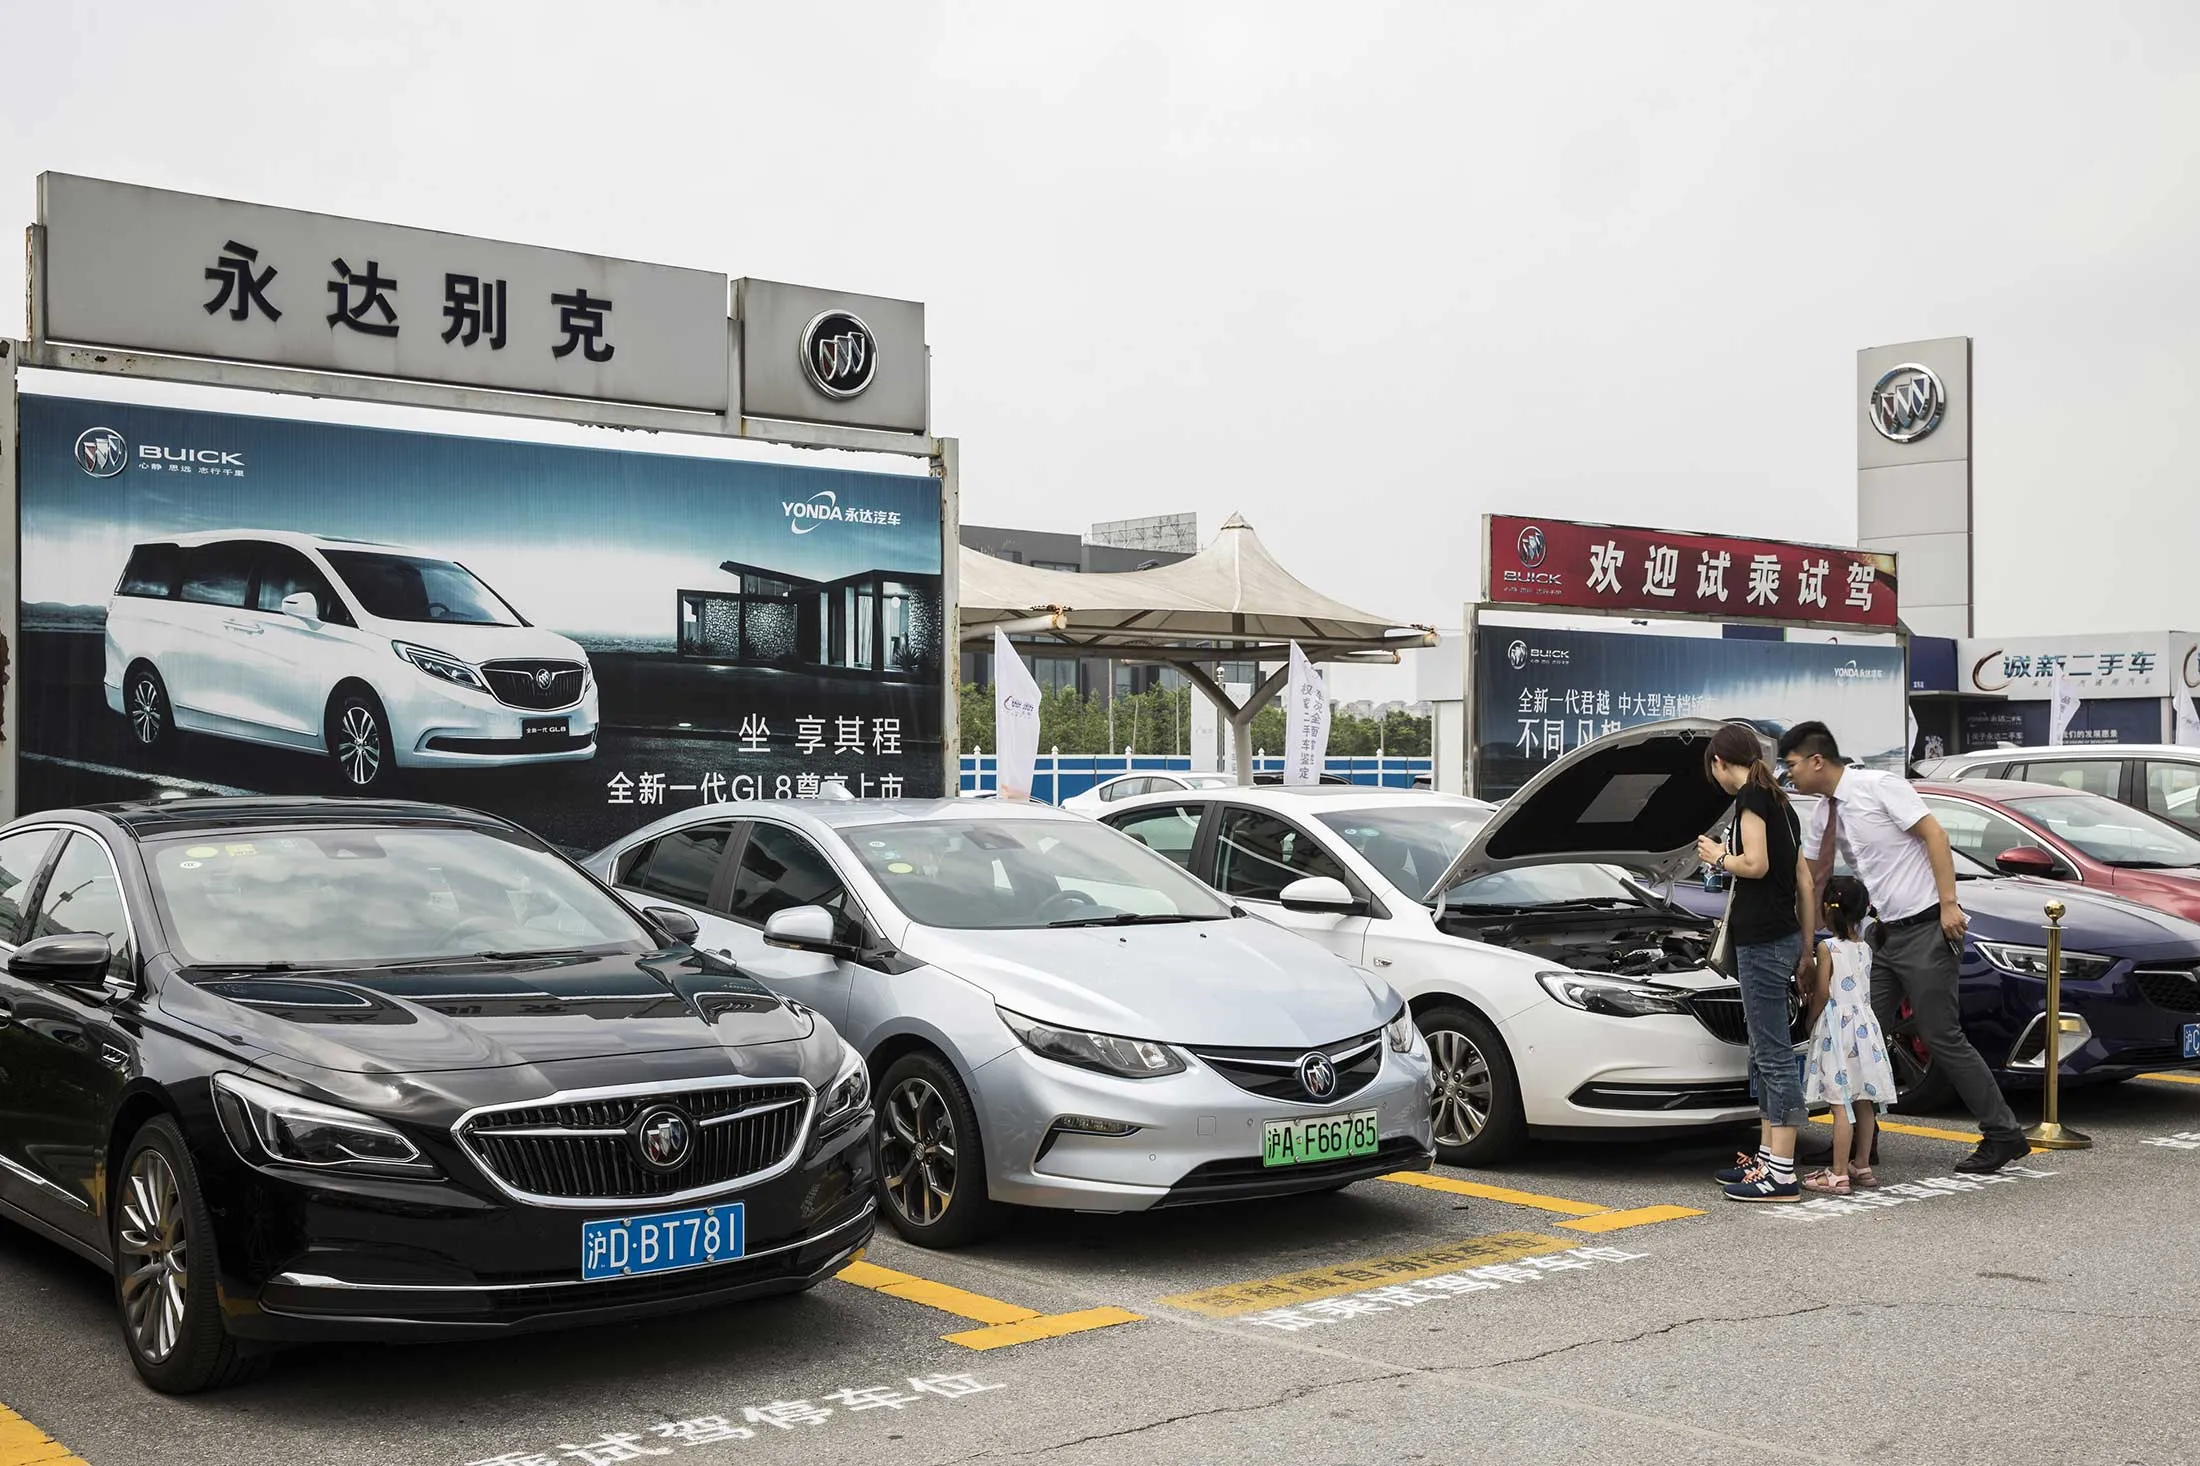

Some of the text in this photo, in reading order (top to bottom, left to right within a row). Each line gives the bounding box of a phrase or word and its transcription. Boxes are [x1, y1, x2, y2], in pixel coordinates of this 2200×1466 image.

[203, 240, 615, 362] 永达别克
[139, 445, 245, 466] BUICK
[139, 462, 162, 472] 心静
[782, 501, 901, 525] YONDA 永达汽车
[1504, 571, 1562, 585] BUICK
[1586, 540, 1876, 612] 欢迎试乘试驾
[1530, 649, 1570, 658] BUICK
[2003, 650, 2156, 679] 诚新二手车
[1518, 687, 1610, 715] 全新一代君越
[738, 713, 902, 756] 坐 享其程
[1516, 718, 1564, 760] 不同
[587, 1213, 735, 1270] 沪D·BT781
[1239, 1245, 1652, 1332] 试乘试驾停车位
